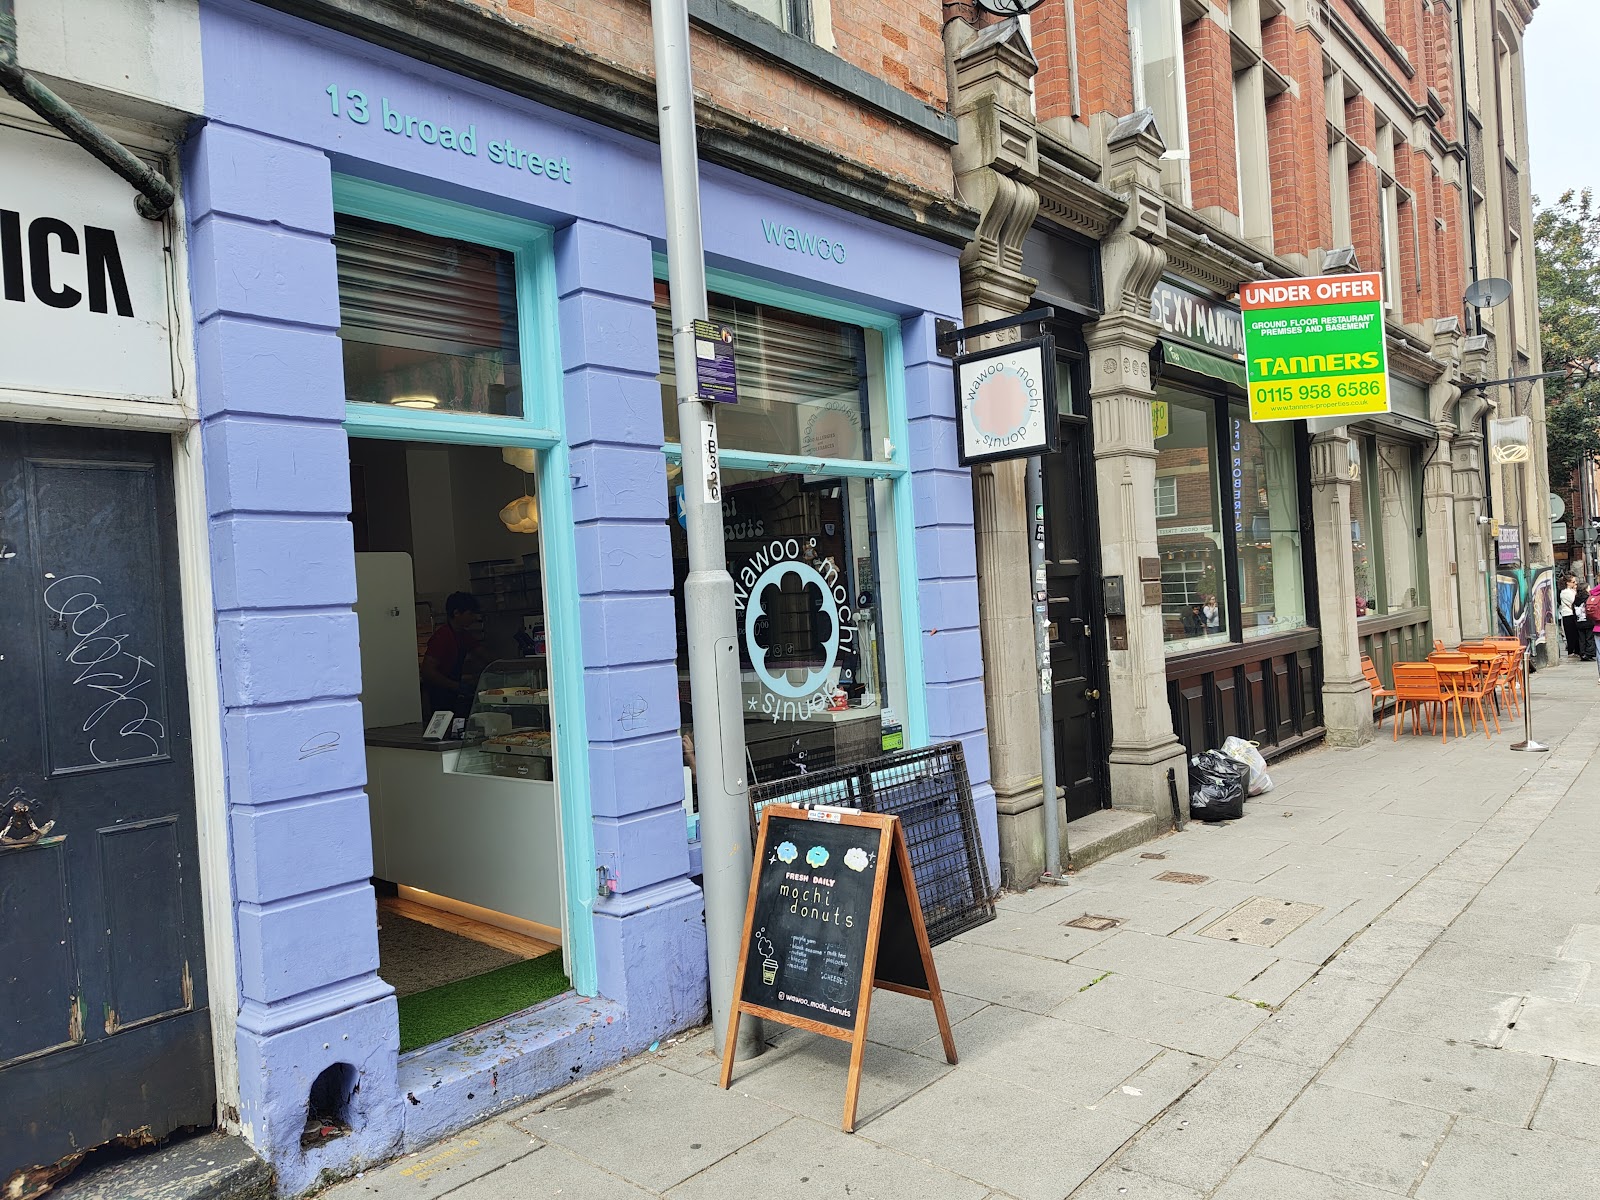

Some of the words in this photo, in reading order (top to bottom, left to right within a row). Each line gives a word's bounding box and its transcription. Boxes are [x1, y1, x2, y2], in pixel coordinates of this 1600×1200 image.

[325, 82, 371, 125] 13
[382, 96, 479, 158] broad
[487, 137, 573, 184] street
[761, 217, 847, 265] wawoo
[1245, 285, 1311, 304] UNDER
[1316, 280, 1375, 299] OFFER
[1251, 320, 1288, 330] GROUND
[1290, 318, 1318, 327] FLOOR
[1321, 313, 1375, 325] RESTAURANT
[1261, 325, 1303, 337] PREMISES
[1305, 324, 1323, 334] AND
[1325, 321, 1370, 332] BASEMENT
[967, 362, 1004, 401] wawoo
[1016, 366, 1042, 413] mochi
[1256, 386, 1293, 403] 0115
[1298, 383, 1331, 400] 958
[1336, 380, 1380, 397] 6586
[1270, 399, 1369, 412] www.tanners-properties.co.uk
[982, 426, 1027, 448] donuts
[735, 538, 799, 610] wawoo
[819, 557, 859, 656] mochi
[785, 871, 809, 882] FRESH
[812, 876, 836, 888] DAILY
[780, 884, 830, 906] mochi
[790, 898, 853, 928] donuts
